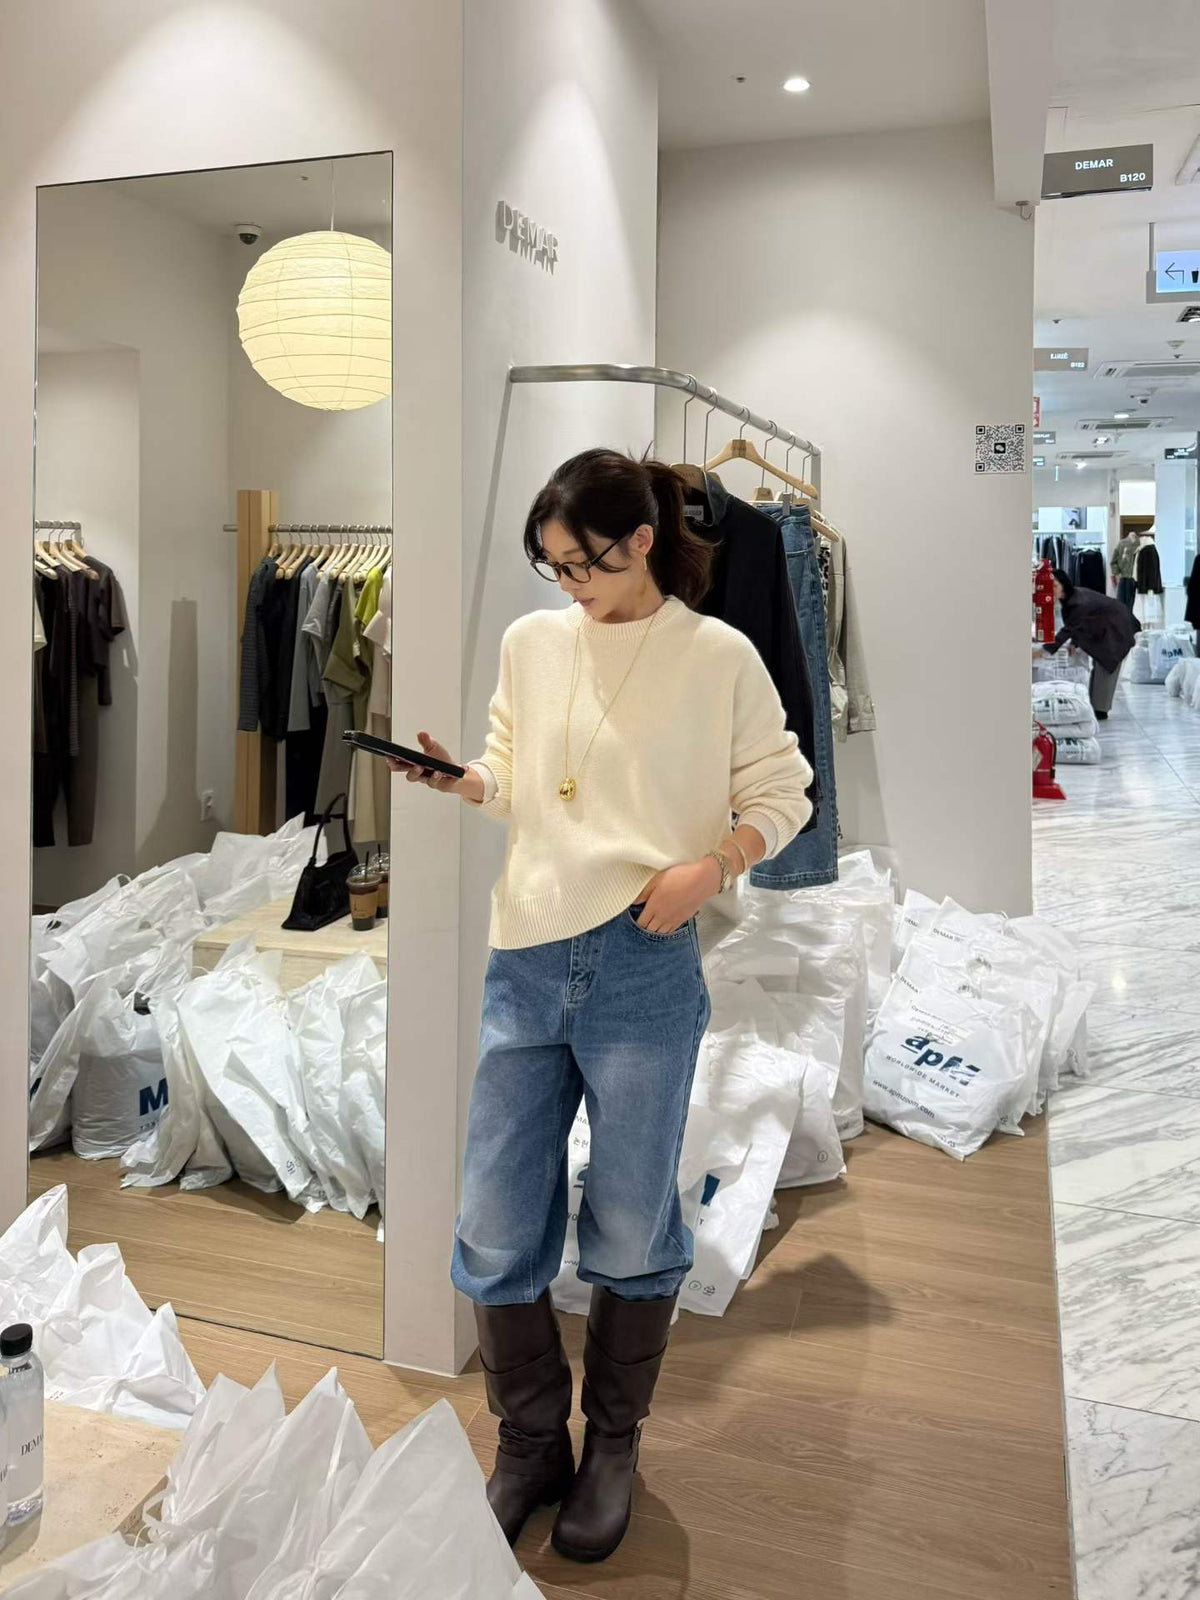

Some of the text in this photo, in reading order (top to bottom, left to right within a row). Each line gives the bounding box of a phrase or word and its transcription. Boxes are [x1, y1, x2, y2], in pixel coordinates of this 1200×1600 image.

[1075, 159, 1114, 170] DEMAR
[1120, 172, 1146, 182] B120
[496, 200, 559, 272] DEMAR
[929, 1077, 960, 1098] MARKET
